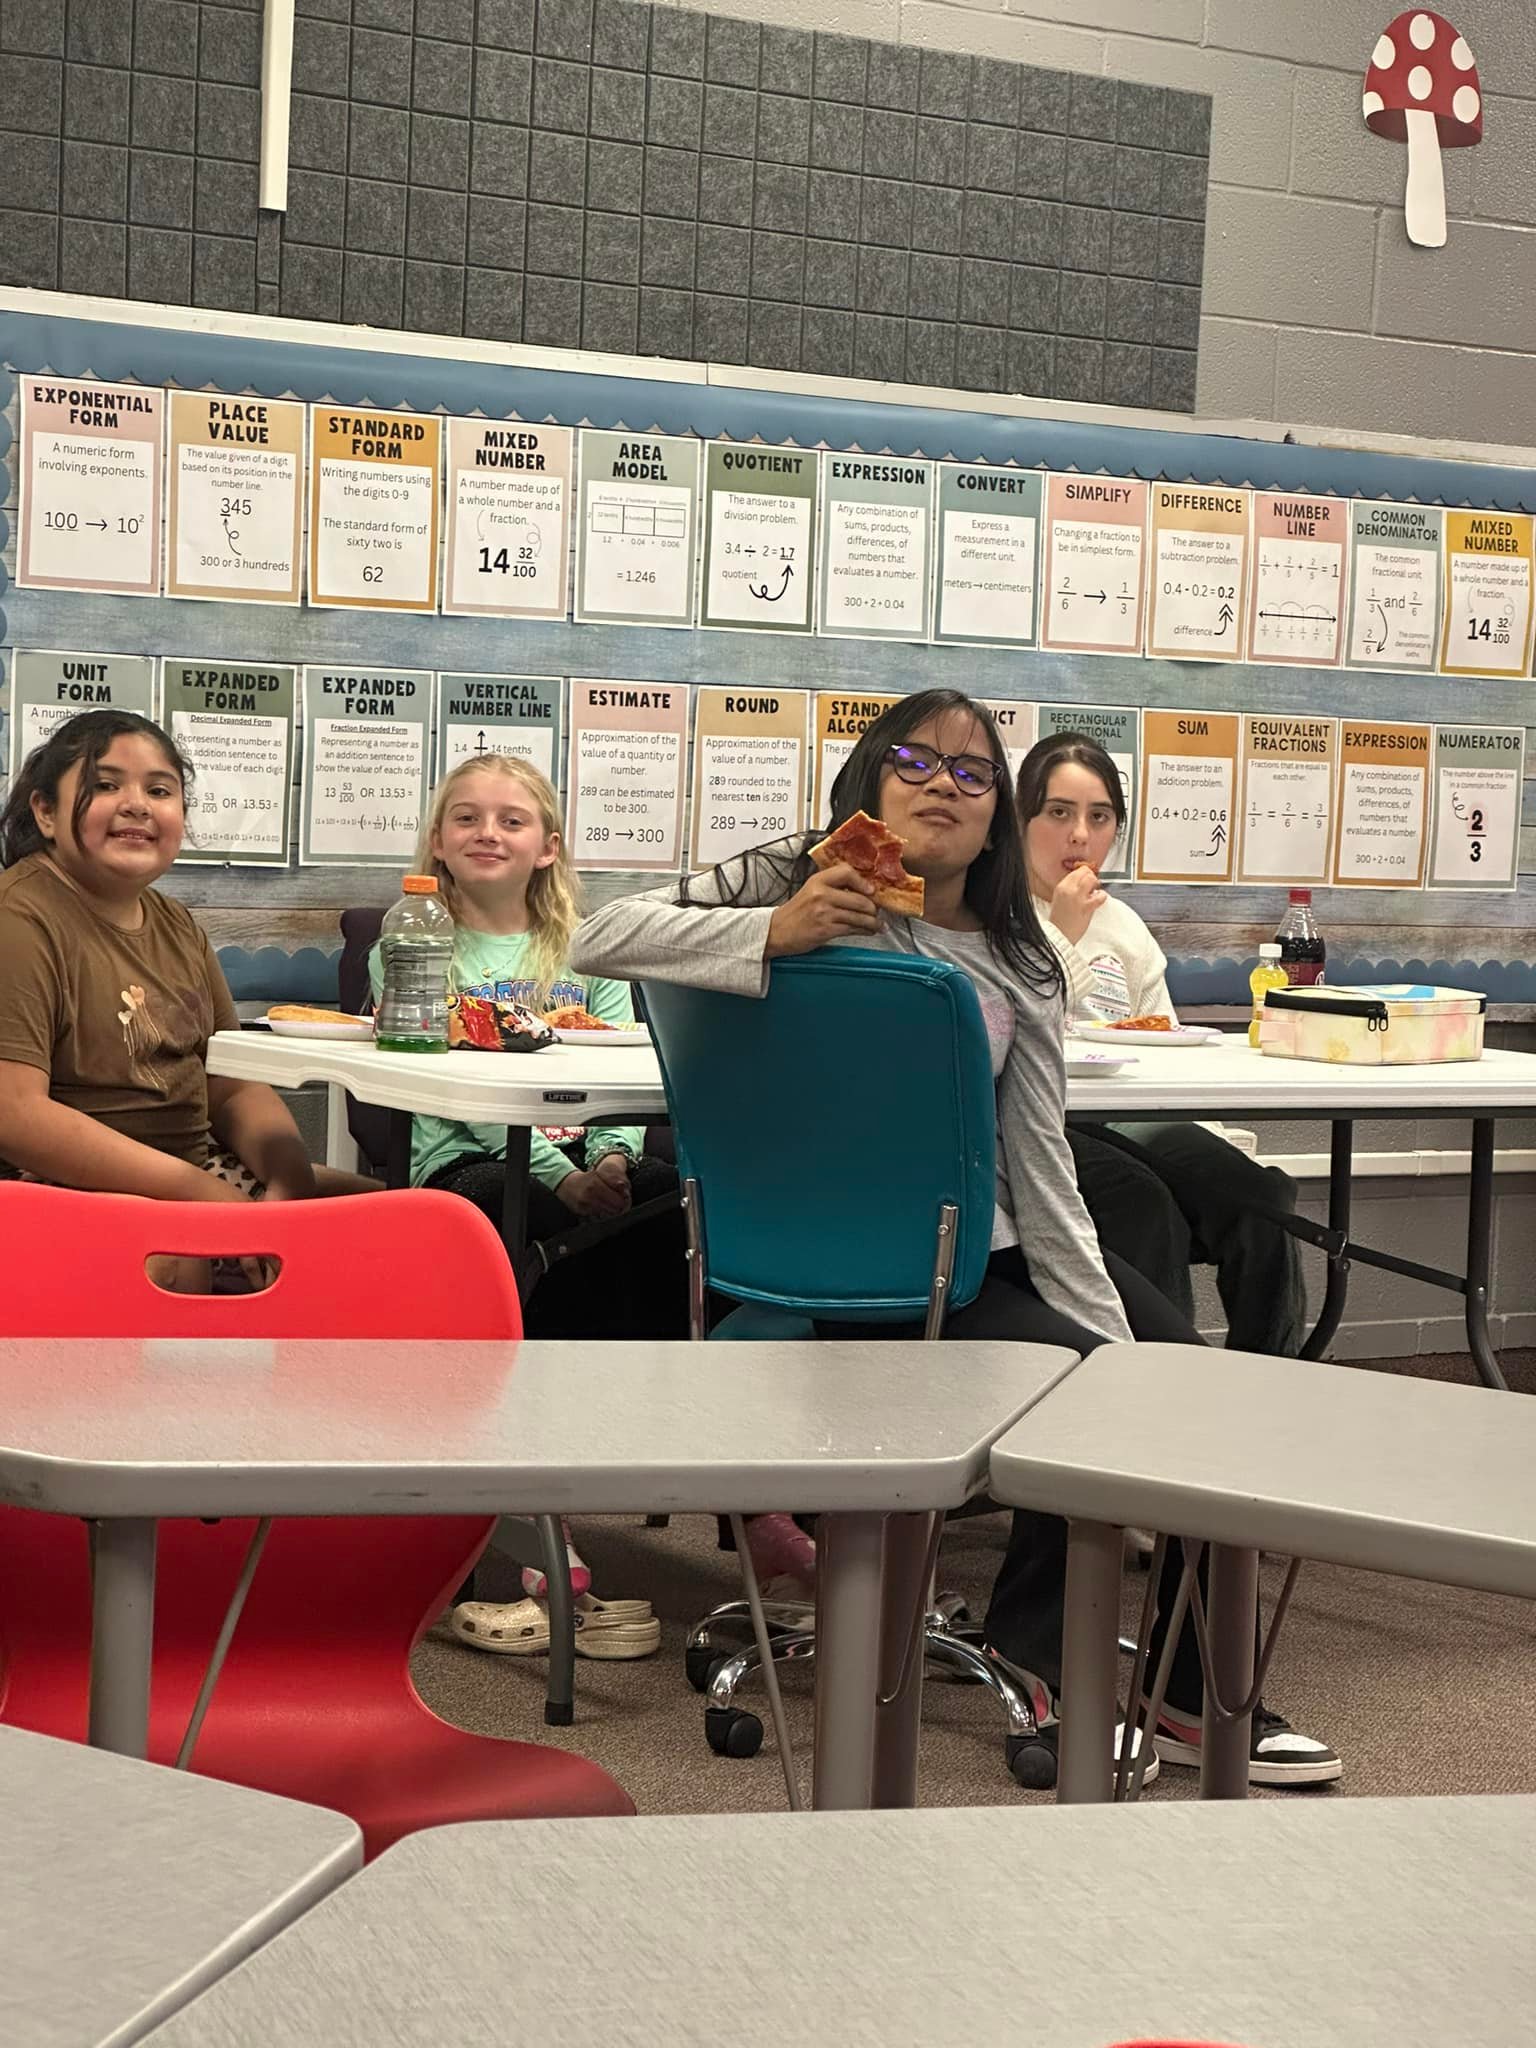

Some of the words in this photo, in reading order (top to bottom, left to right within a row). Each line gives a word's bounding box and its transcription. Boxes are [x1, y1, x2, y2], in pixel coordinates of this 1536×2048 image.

[34, 387, 152, 412] EXPONENTIAL
[70, 410, 118, 428] FORM
[210, 402, 268, 422] PLACE
[208, 422, 268, 443] VALUE
[329, 417, 425, 440] STANDARD
[484, 431, 538, 450] MIXED
[53, 442, 60, 452] A
[63, 445, 107, 457] numeric
[110, 447, 134, 459] form
[352, 439, 402, 459] FORM
[619, 443, 662, 461] AREA
[39, 458, 87, 476] involving
[476, 450, 545, 470] NUMBER
[723, 453, 802, 474] QUOTIENT
[322, 467, 358, 482] Writing
[360, 472, 403, 483] numbers
[406, 474, 431, 488] using
[612, 462, 668, 481] MODEL
[833, 462, 925, 484] EXPRESSION
[460, 478, 467, 487] A
[469, 480, 506, 490] number
[508, 483, 534, 493] made
[536, 486, 548, 496] up
[550, 485, 560, 495] of
[957, 474, 1025, 494] CONVERT
[344, 485, 360, 496] the
[363, 488, 389, 500] digits
[392, 489, 409, 500] 0-9
[1066, 485, 1131, 503] SIMPLIFY
[220, 498, 251, 516] 345
[459, 496, 464, 504] a
[467, 496, 495, 506] whole
[497, 499, 534, 509] number
[536, 501, 553, 510] and
[729, 494, 745, 504] The
[746, 495, 778, 507] answer
[779, 500, 788, 508] to
[1161, 494, 1241, 513] DIFFERENCE
[724, 510, 758, 520] division
[838, 504, 854, 516] Any
[856, 504, 909, 518] combination
[910, 508, 920, 519] of
[1274, 503, 1329, 520] NUMBER
[1371, 510, 1425, 526] COMMON
[45, 512, 78, 531] 100
[323, 518, 341, 528] The
[344, 521, 388, 532] standard
[392, 522, 414, 533] form
[417, 525, 427, 534] of
[972, 520, 1003, 531] Express
[1287, 520, 1316, 536] LINE
[1471, 520, 1512, 535] MIXED
[1357, 524, 1438, 541] DENOMINATOR
[347, 536, 370, 550] sixty
[373, 539, 392, 549] two
[395, 539, 402, 550] is
[1465, 537, 1518, 552] NUMBER
[519, 547, 532, 559] 32
[725, 543, 740, 554] 3.4
[763, 545, 769, 557] 2
[780, 547, 794, 560] 1.7
[200, 556, 220, 566] 300
[234, 558, 240, 568] 3
[243, 559, 289, 571] hundreds
[479, 547, 510, 574] 14
[363, 566, 383, 582] 62
[513, 565, 536, 578] 100
[626, 571, 656, 583] 1.246
[722, 570, 757, 580] quotient
[945, 580, 972, 589] meters
[984, 583, 1031, 593] centimeters
[1164, 582, 1181, 594] 0.4
[1192, 584, 1207, 597] 0.2
[1218, 586, 1234, 599] 0.2
[844, 597, 862, 607] 300
[884, 600, 904, 609] 0.04
[1384, 596, 1405, 608] and
[1173, 625, 1212, 636] difference
[1468, 618, 1491, 640] 14
[1498, 618, 1508, 628] 32
[1493, 634, 1510, 644] 100
[63, 663, 108, 680] UNIT
[182, 670, 279, 692] EXPANDED
[323, 677, 415, 696] EXPANDED
[57, 683, 111, 702] FORM
[465, 683, 537, 700] VERTICAL
[589, 690, 671, 709] ESTIMATE
[205, 692, 255, 710] FORM
[345, 699, 394, 715] FORM
[450, 700, 512, 716] NUMBER
[519, 703, 551, 718] LINE
[725, 697, 779, 714] ROUND
[832, 701, 894, 716] STANDA
[828, 719, 873, 734] ALGO
[1051, 713, 1126, 726] RECTANGULAR
[1177, 721, 1208, 735] SUM
[1251, 722, 1329, 738] EQUIVALENT
[582, 731, 649, 744] Approximation
[651, 735, 660, 744] of
[662, 736, 676, 745] the
[706, 738, 772, 749] Approximation
[772, 740, 780, 749] of
[782, 740, 796, 750] the
[1253, 738, 1326, 753] FRACTIONS
[1345, 733, 1427, 750] EXPRESSION
[1439, 733, 1520, 751] NUMERATOR
[455, 744, 467, 752] 1.4
[491, 745, 501, 754] 14
[504, 745, 532, 755] tenths
[582, 748, 606, 758] value
[608, 748, 618, 758] of
[627, 752, 664, 763] quantity
[709, 776, 726, 785] 289
[728, 777, 764, 786] rounded
[766, 778, 776, 786] to
[777, 777, 791, 787] the
[763, 792, 769, 802] is
[771, 793, 788, 802] 290
[1152, 807, 1170, 819] 0.4
[1182, 808, 1198, 821] 0.2
[1210, 810, 1226, 821] 0.6
[711, 816, 735, 829] 289
[761, 817, 786, 830] 290
[586, 827, 609, 841] 289
[637, 829, 664, 843] 300
